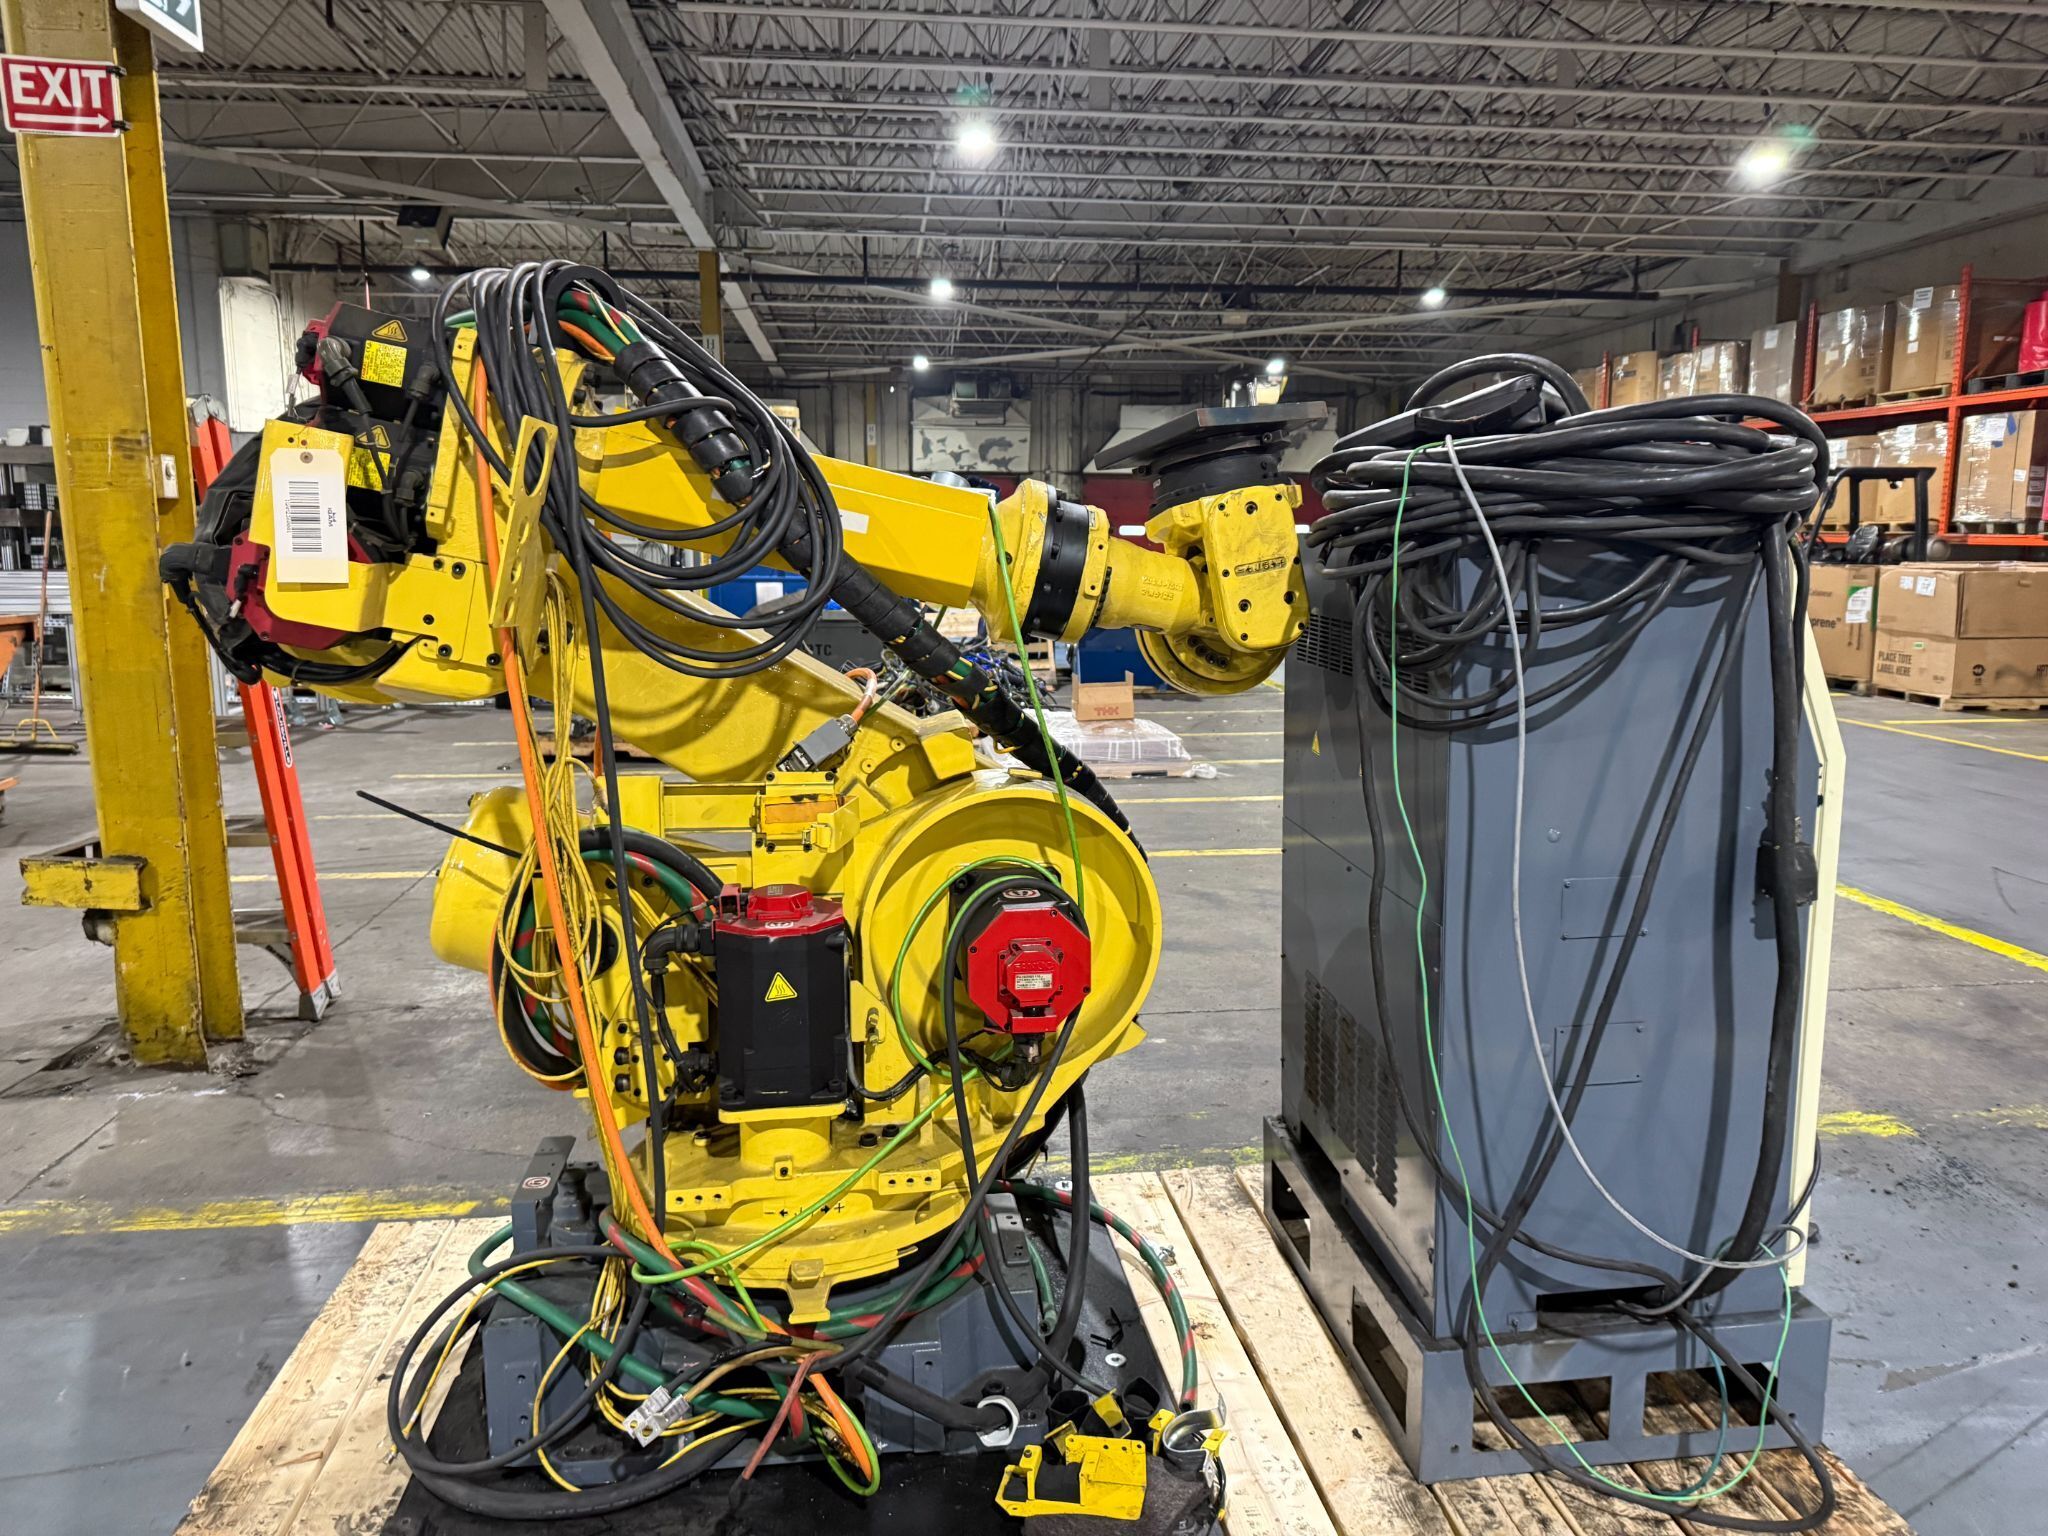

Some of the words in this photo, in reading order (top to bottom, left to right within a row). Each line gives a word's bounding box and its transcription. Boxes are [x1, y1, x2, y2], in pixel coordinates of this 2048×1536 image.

[8, 63, 107, 109] EXIT
[1878, 650, 1897, 663] PLACE
[1898, 653, 1912, 664] TOTE
[1877, 663, 1895, 674] LABEL
[1896, 666, 1911, 677] HERE
[1094, 706, 1120, 716] THK
